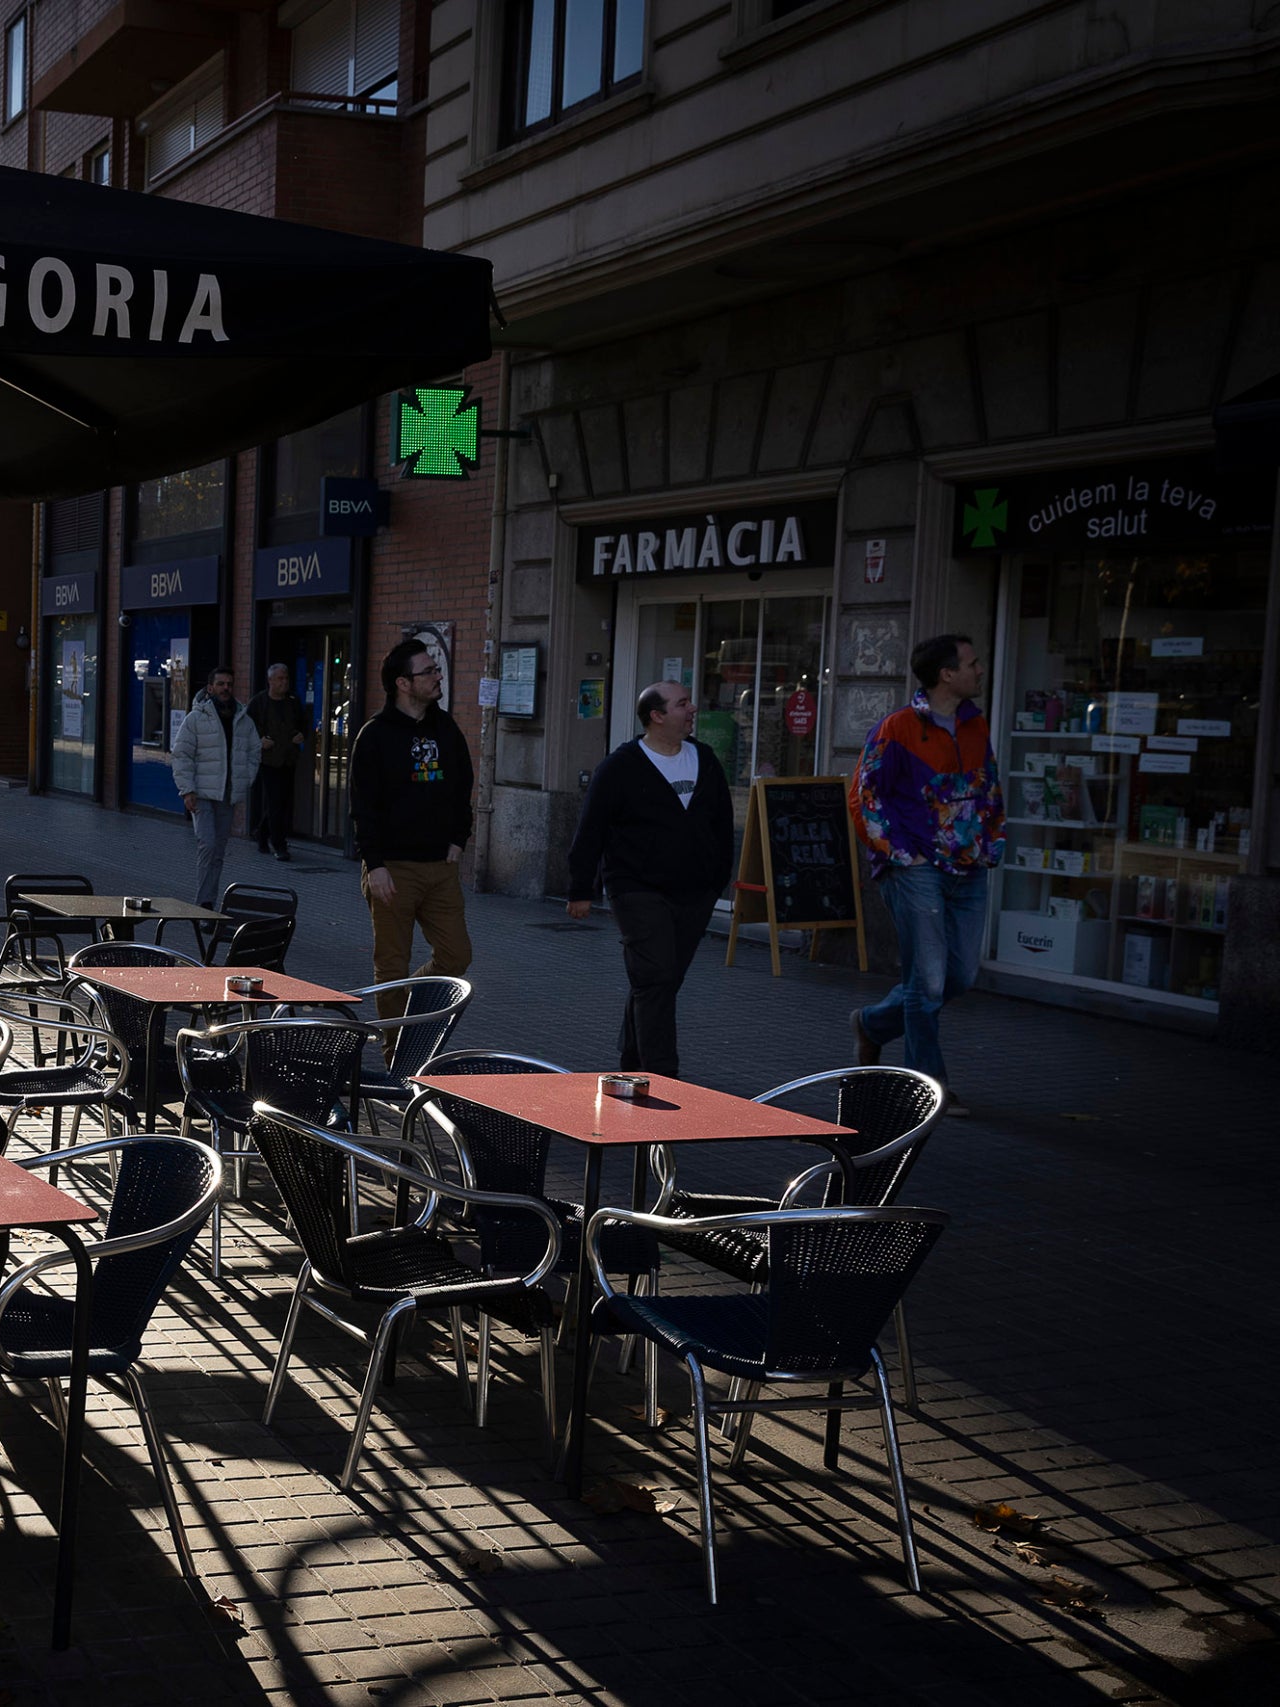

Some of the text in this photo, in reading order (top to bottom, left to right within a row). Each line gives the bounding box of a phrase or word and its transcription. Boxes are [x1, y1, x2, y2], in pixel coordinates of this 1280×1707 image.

[328, 499, 373, 515] BBVA
[1026, 475, 1218, 534] cuidem la teva
[1086, 508, 1149, 539] salut
[592, 514, 807, 576] FARMÀCIA
[150, 568, 183, 598] BBVA
[277, 551, 322, 587] BBVA
[55, 582, 80, 607] BBVA
[790, 843, 836, 865] REAL
[1017, 931, 1054, 948] Eucerin
